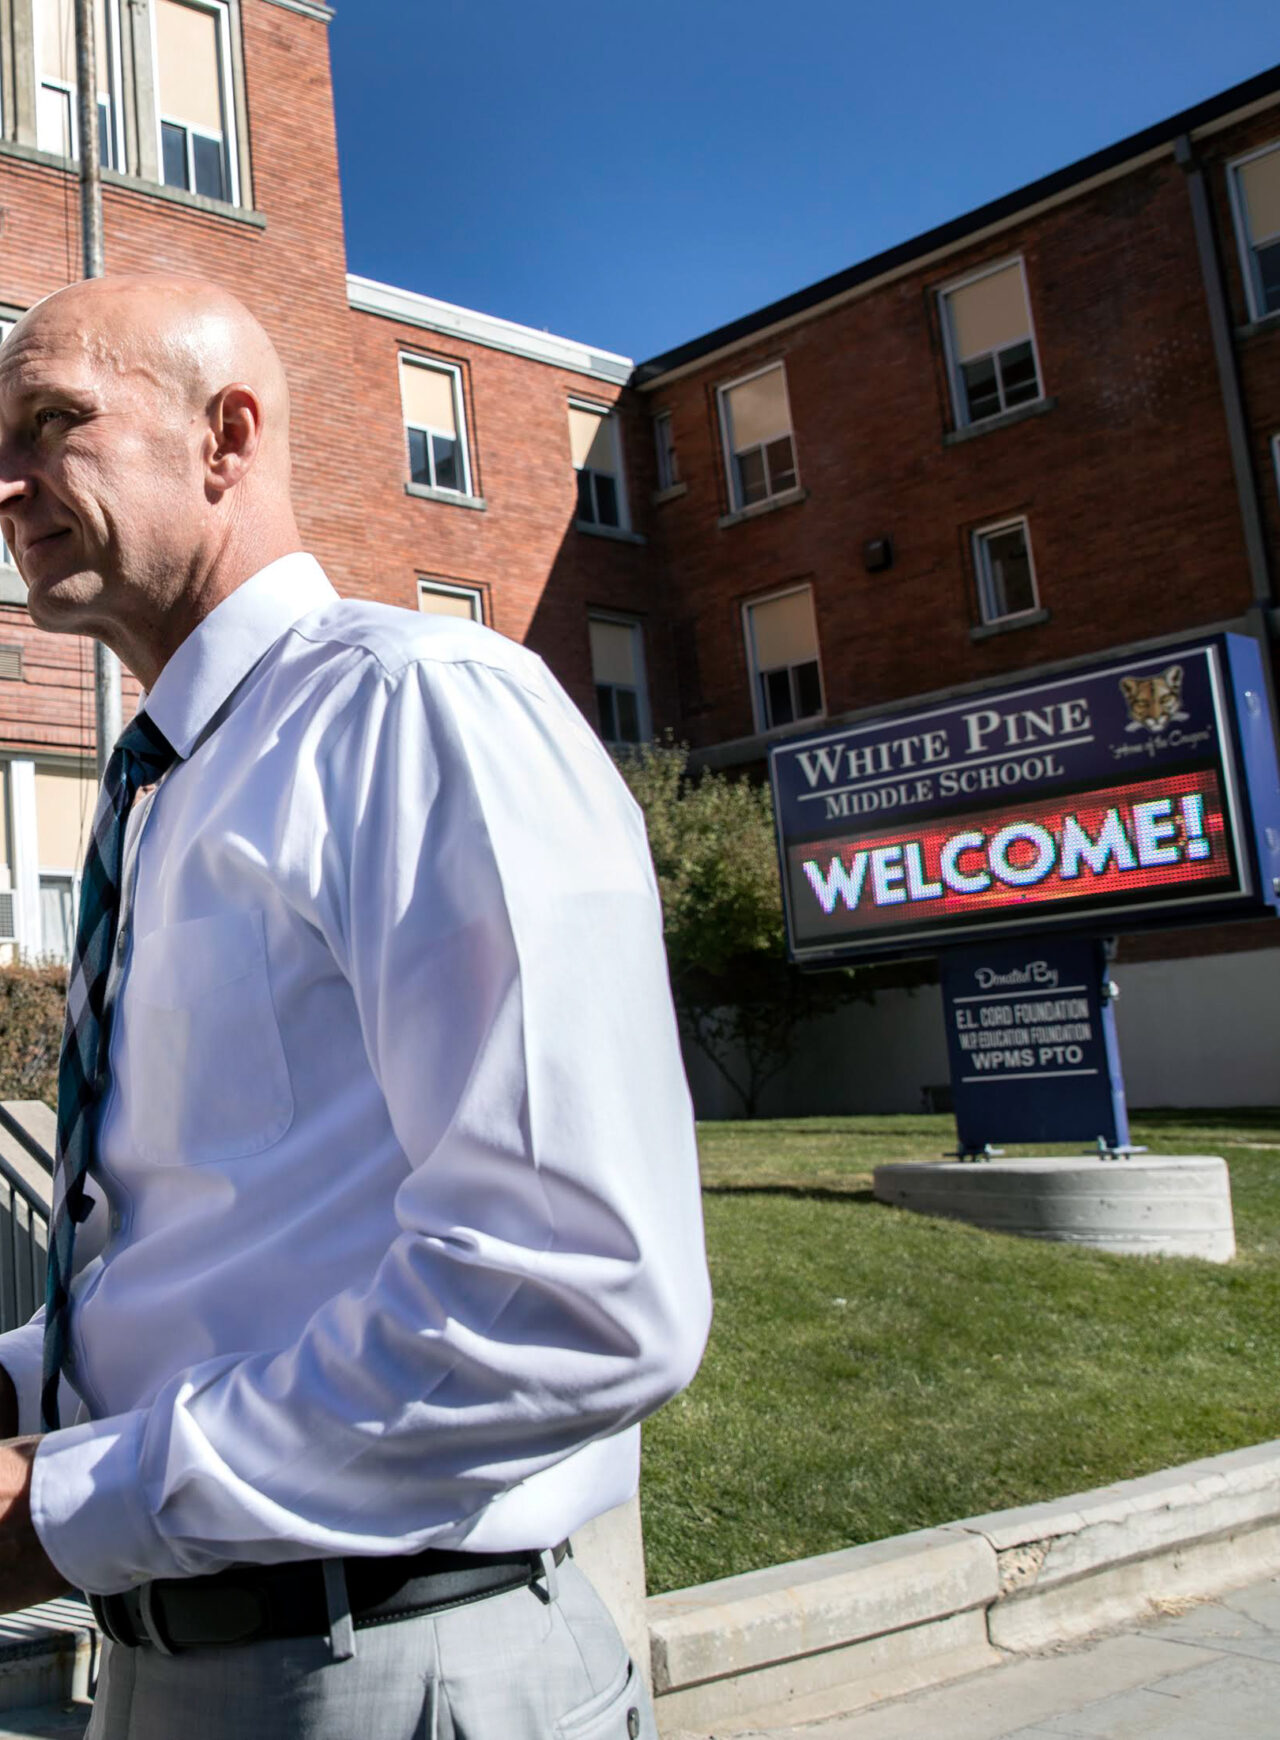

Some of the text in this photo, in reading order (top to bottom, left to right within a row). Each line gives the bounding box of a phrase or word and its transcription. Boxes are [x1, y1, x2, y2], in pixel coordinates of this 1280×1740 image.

[795, 698, 1091, 788] WHITE PINE
[825, 755, 1064, 820] MIDDLE SCHOOL
[803, 793, 1211, 915] WELCOME!
[1031, 960, 1059, 989] By
[980, 1005, 1014, 1028] CORD
[1014, 998, 1089, 1024] FOUNDATION
[978, 1027, 1030, 1050] EDUCATION
[1030, 1023, 1092, 1045] FOUNDATION
[972, 1045, 1084, 1070] WPMS PTO
